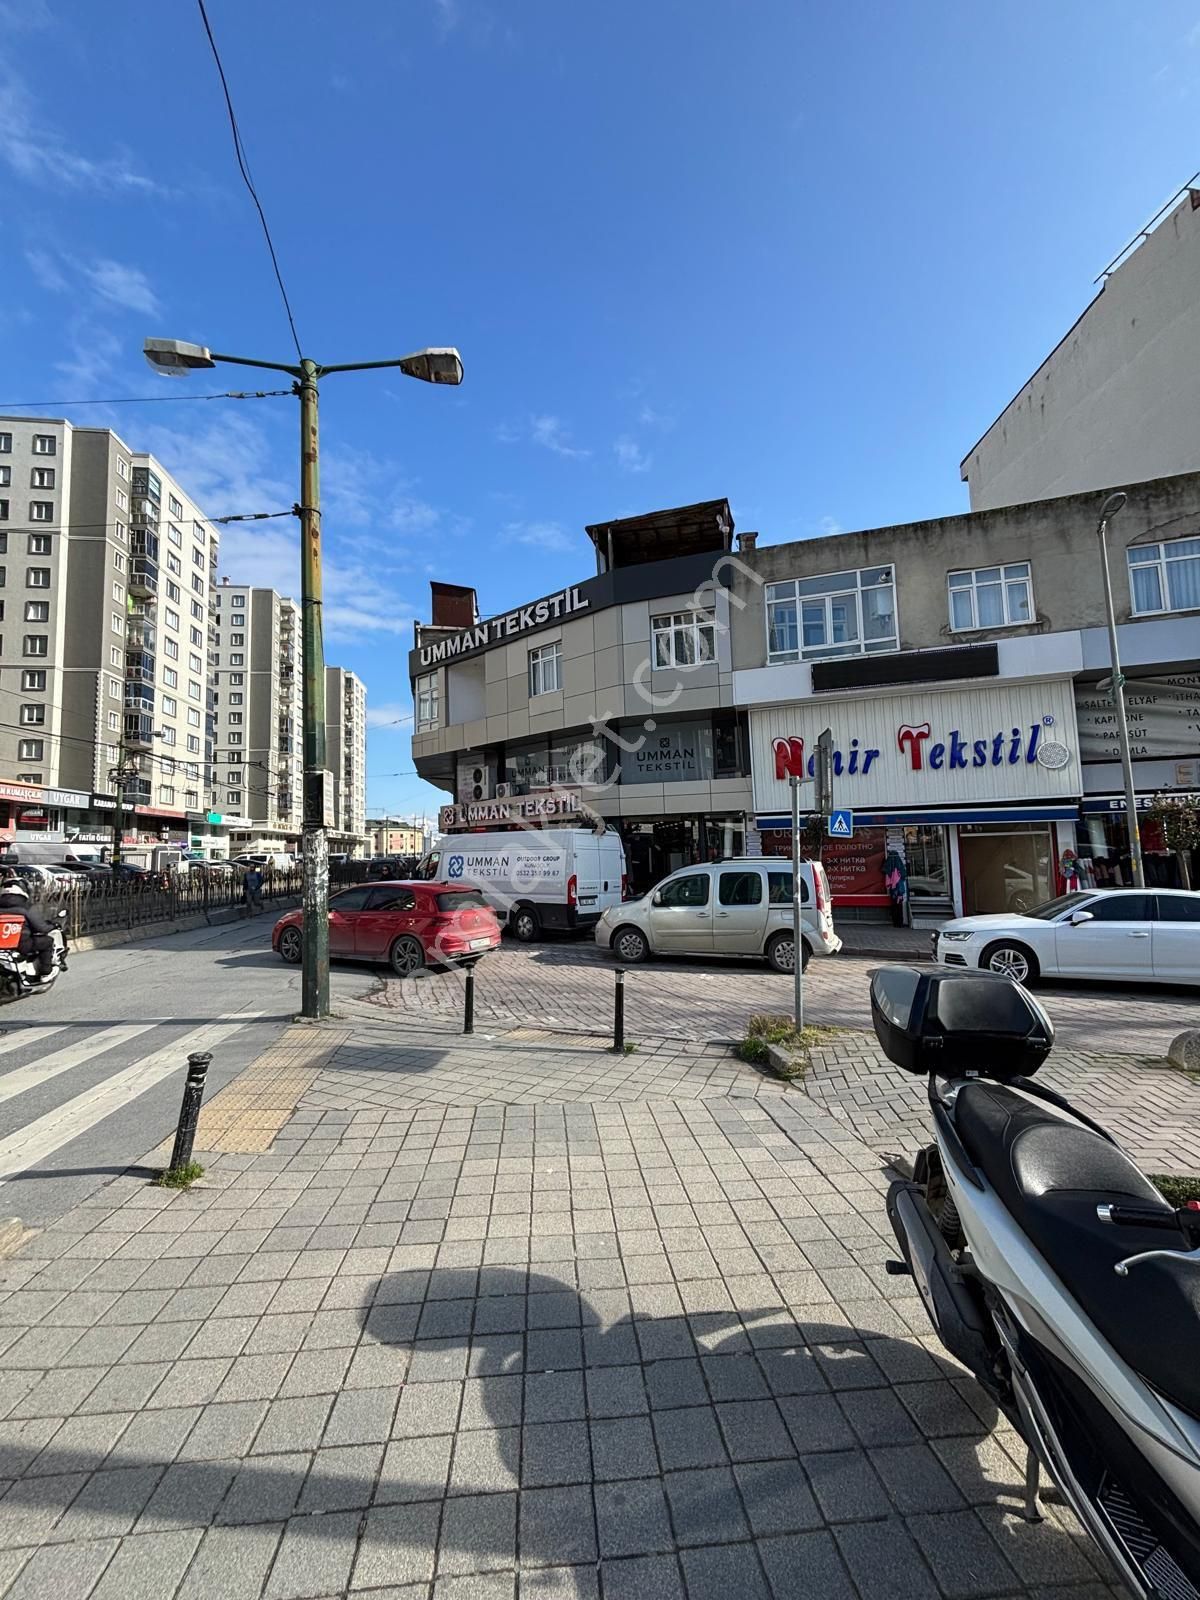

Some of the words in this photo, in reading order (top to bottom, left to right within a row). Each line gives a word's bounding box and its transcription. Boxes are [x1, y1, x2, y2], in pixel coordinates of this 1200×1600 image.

[420, 624, 489, 667] UMMAN
[492, 587, 589, 639] TEKSTİL
[1128, 695, 1158, 706] ELYAF
[1094, 713, 1145, 725] KAPIONE
[1103, 727, 1148, 740] PARSÜT
[897, 722, 1041, 771] Tekstil
[1112, 746, 1148, 756] DMLA
[637, 748, 694, 762] UMMAN
[637, 760, 695, 772] TEKSTİL
[54, 791, 80, 805] UYGAR
[518, 792, 582, 816] TEKSTİL
[30, 833, 52, 841] UYGAR
[467, 856, 510, 867] UMMAN
[467, 867, 509, 877] TEKSTİL
